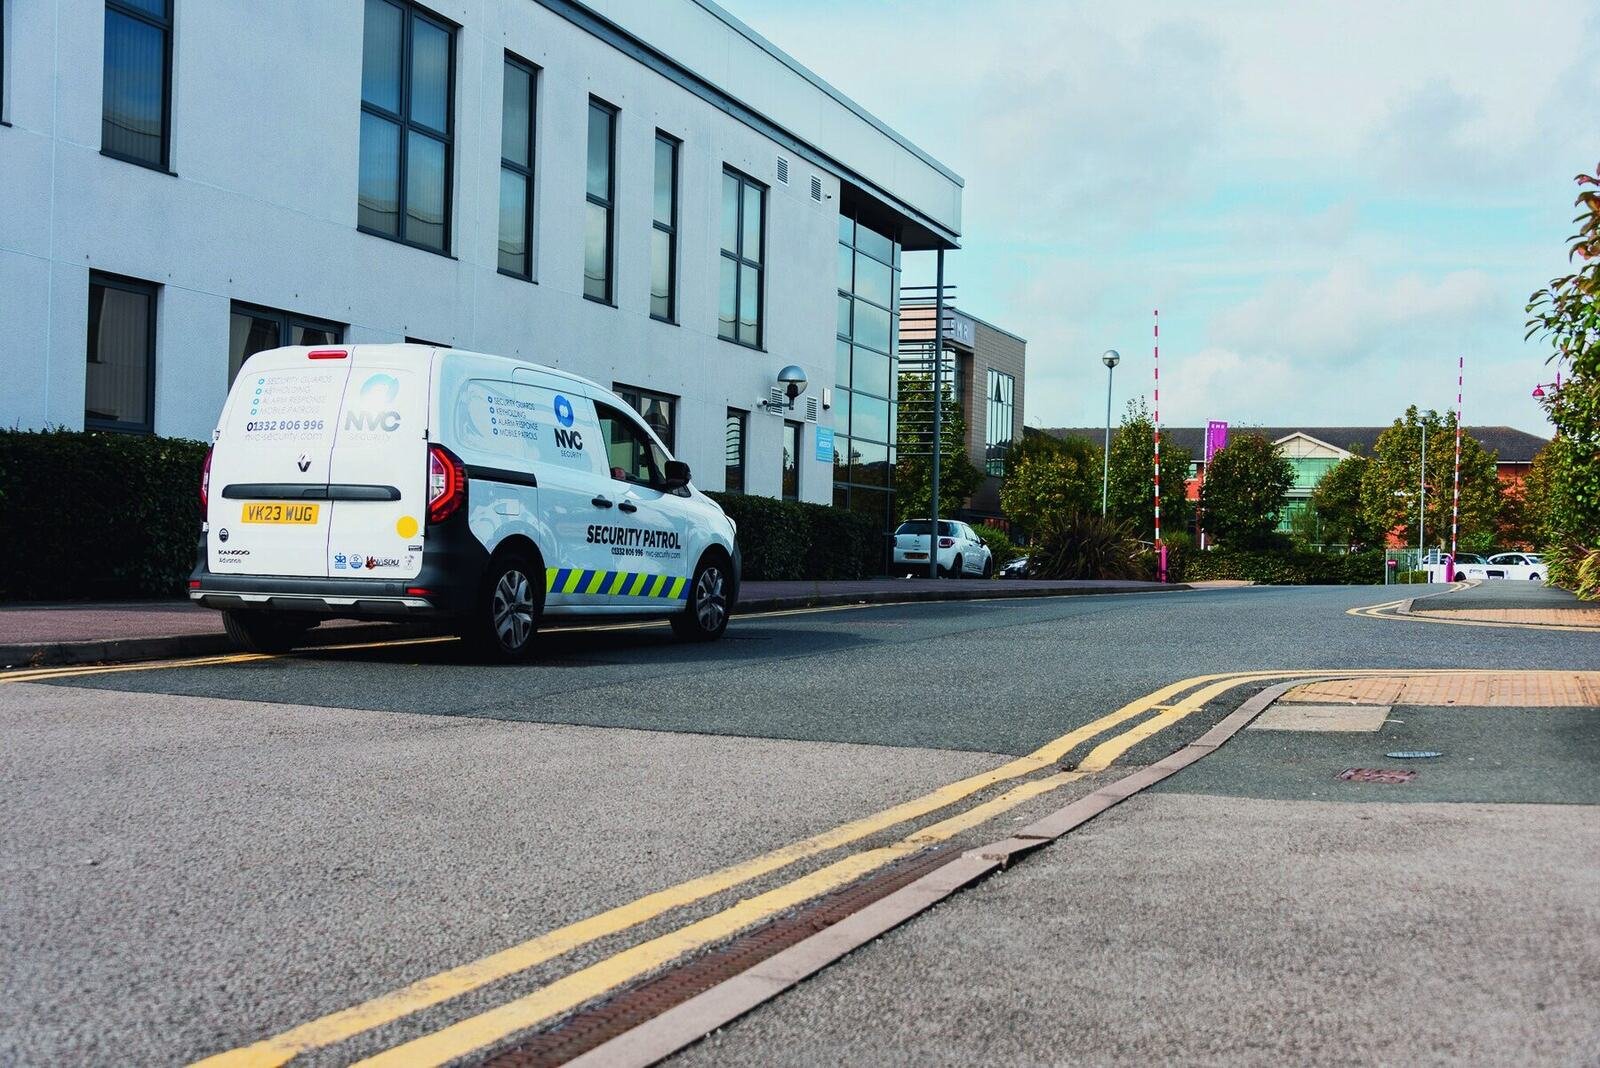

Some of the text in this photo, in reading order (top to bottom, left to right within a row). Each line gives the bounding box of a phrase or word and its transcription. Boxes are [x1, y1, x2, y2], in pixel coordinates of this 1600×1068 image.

[516, 400, 536, 411] GUARDS
[246, 420, 324, 432] 01332 806 996
[345, 410, 401, 432] NVC
[498, 418, 538, 431] ALARM RESPONSE
[499, 429, 538, 441] MOBILE PATROLS
[554, 428, 583, 450] NVC
[560, 450, 583, 460] SECURITY
[248, 506, 313, 522] VK23 WUG
[586, 525, 681, 550] SECURITY PATROL
[611, 547, 681, 560] 01332 806 996 nvc-security.com
